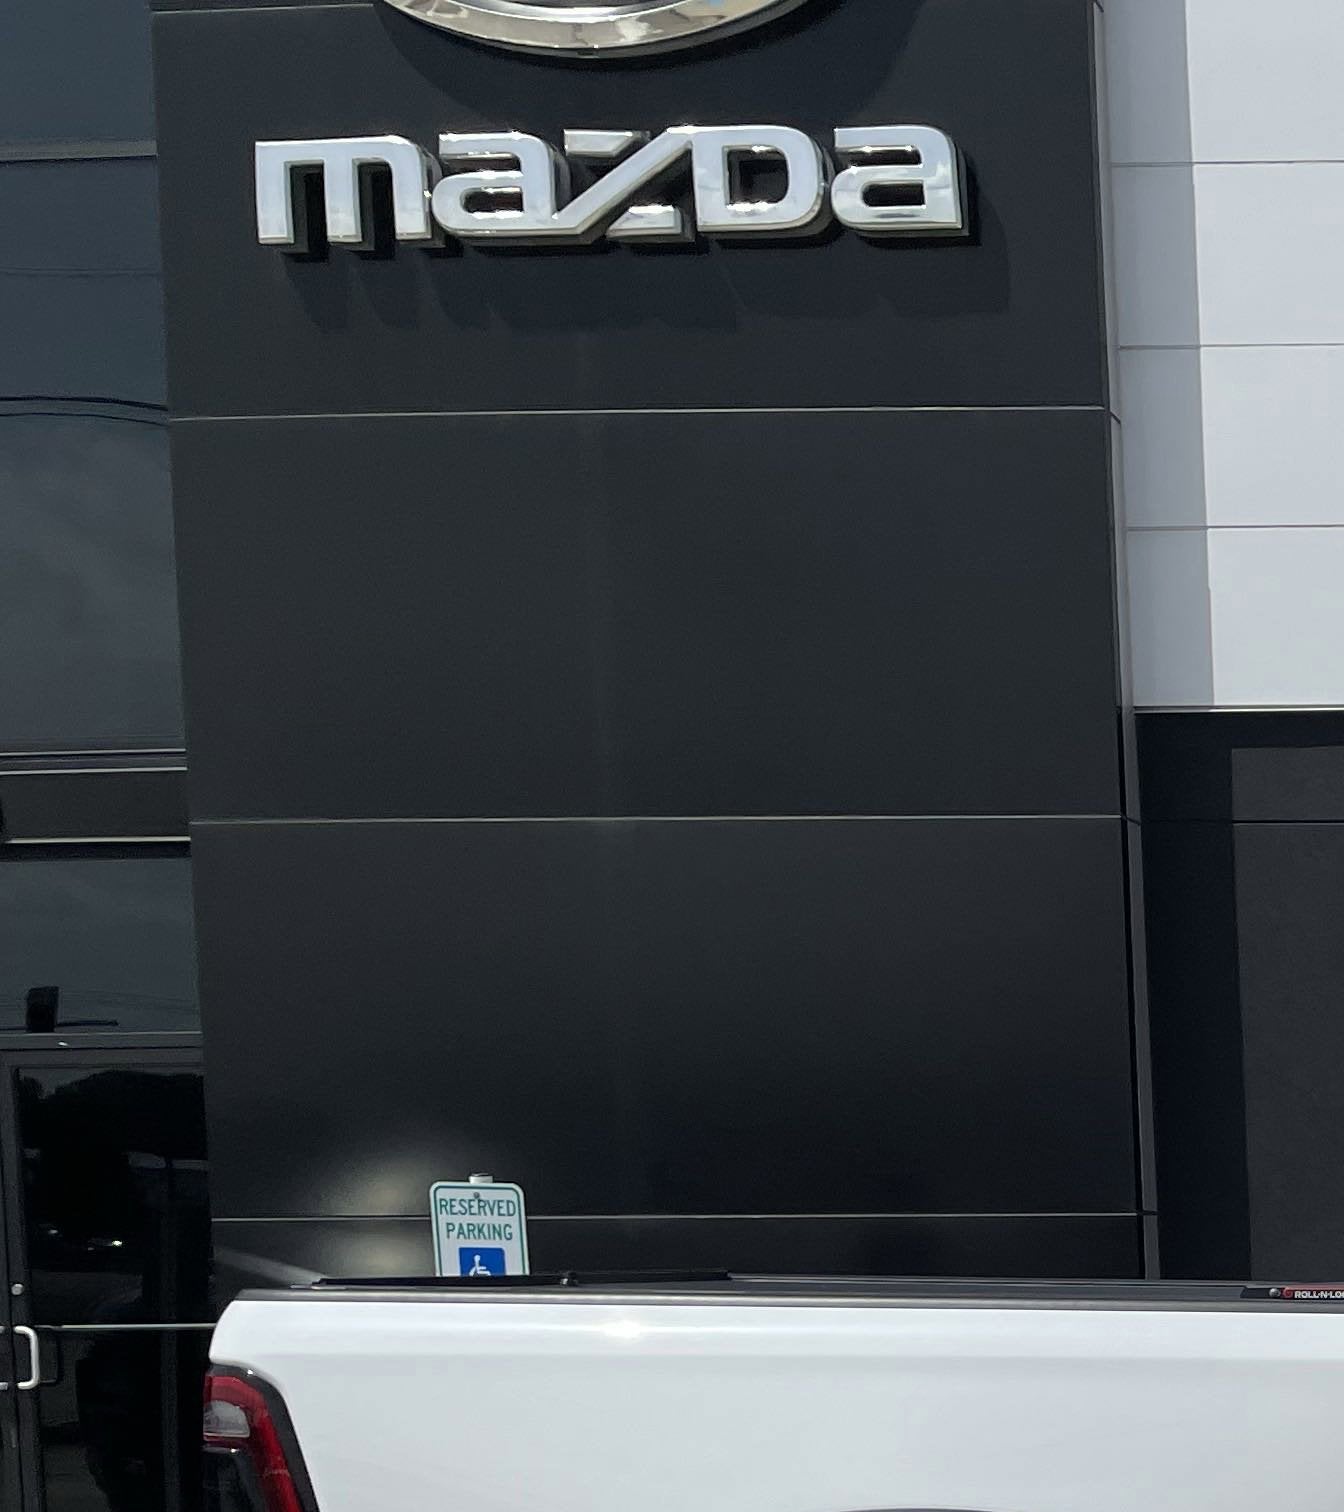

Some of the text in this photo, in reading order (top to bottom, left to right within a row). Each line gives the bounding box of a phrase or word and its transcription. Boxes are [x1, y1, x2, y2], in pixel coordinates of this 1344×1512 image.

[254, 124, 970, 244] mazda
[440, 1198, 516, 1217] RESERVED
[446, 1222, 513, 1241] PARKING
